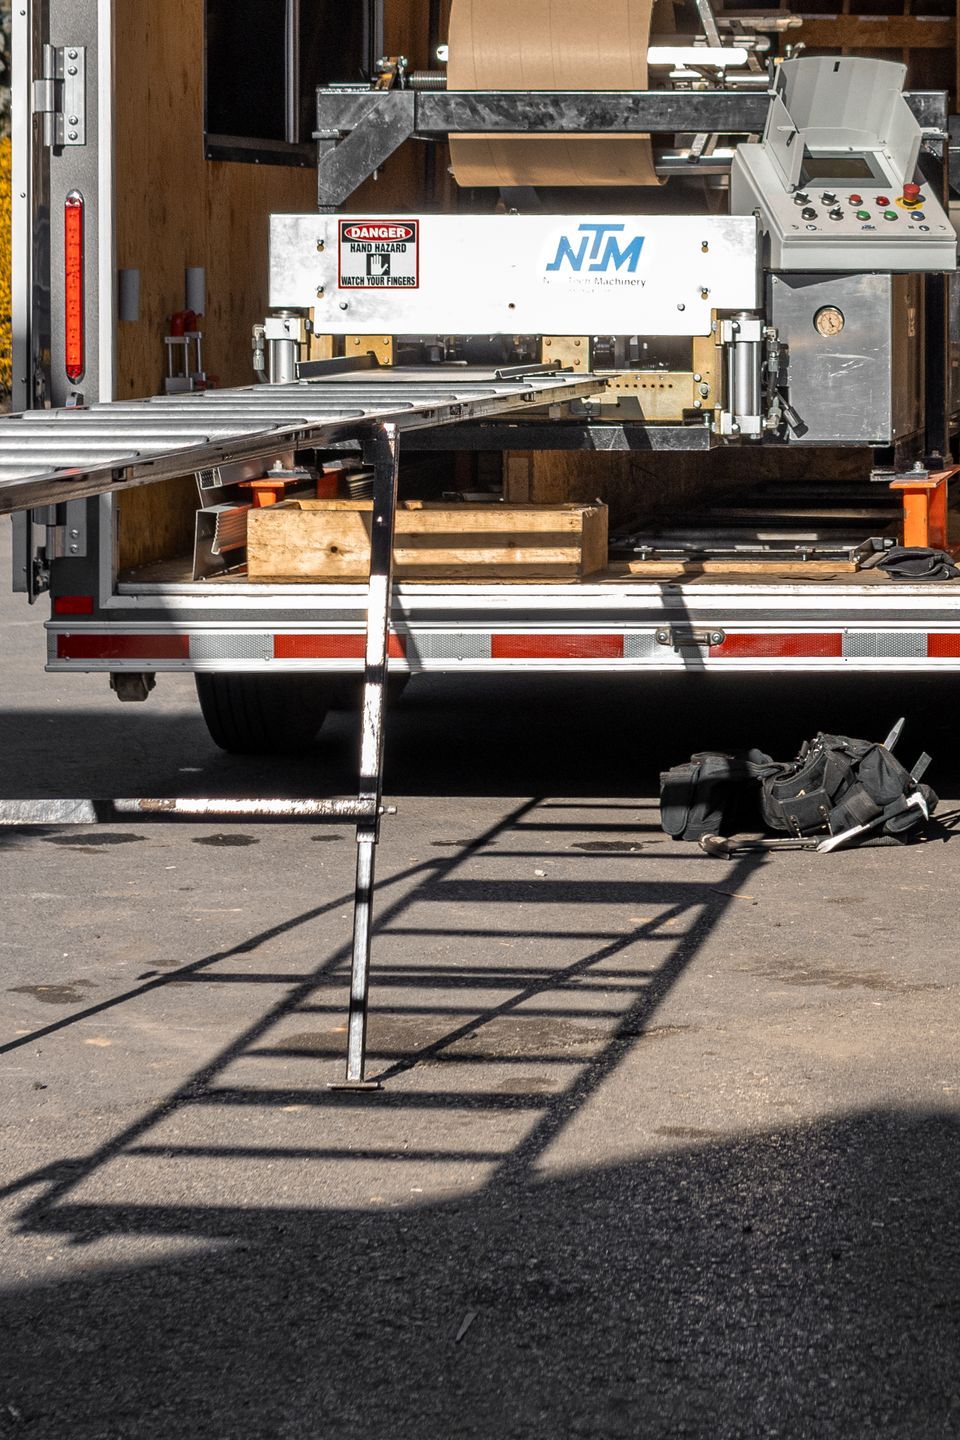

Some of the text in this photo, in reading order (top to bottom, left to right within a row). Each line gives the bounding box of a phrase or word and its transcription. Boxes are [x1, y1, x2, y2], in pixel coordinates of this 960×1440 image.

[350, 227, 406, 238] DANGER
[350, 243, 406, 253] HAND HAZARD
[546, 224, 645, 272] NTM
[341, 276, 415, 286] WATCH YOUR FINGERS
[594, 277, 646, 288] Machinery
